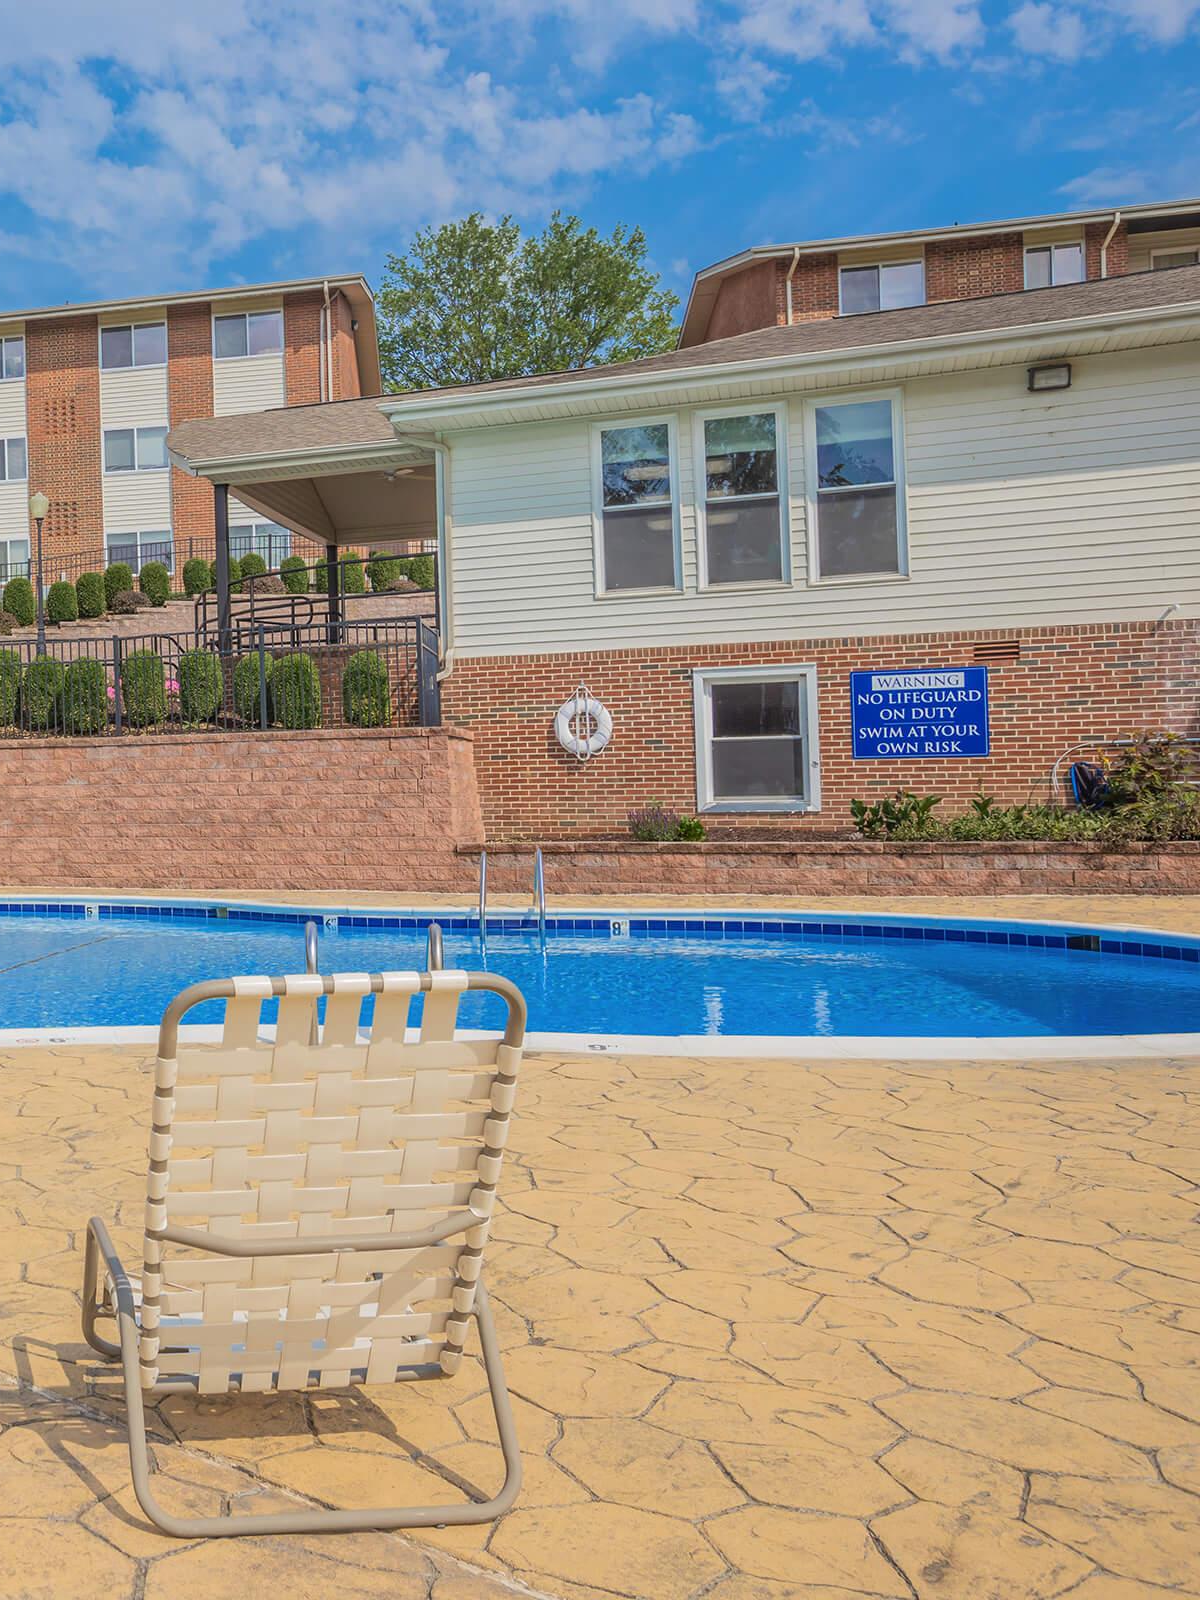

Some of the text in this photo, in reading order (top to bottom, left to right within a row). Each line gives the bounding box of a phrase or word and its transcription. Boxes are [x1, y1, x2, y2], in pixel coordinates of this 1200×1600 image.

[876, 675, 960, 688] WARNING
[857, 690, 981, 705] NO LIFEGUARD
[880, 706, 957, 720] ON DUTY
[859, 724, 980, 739] SWIM AT YOUR
[877, 741, 962, 754] OWN RISK
